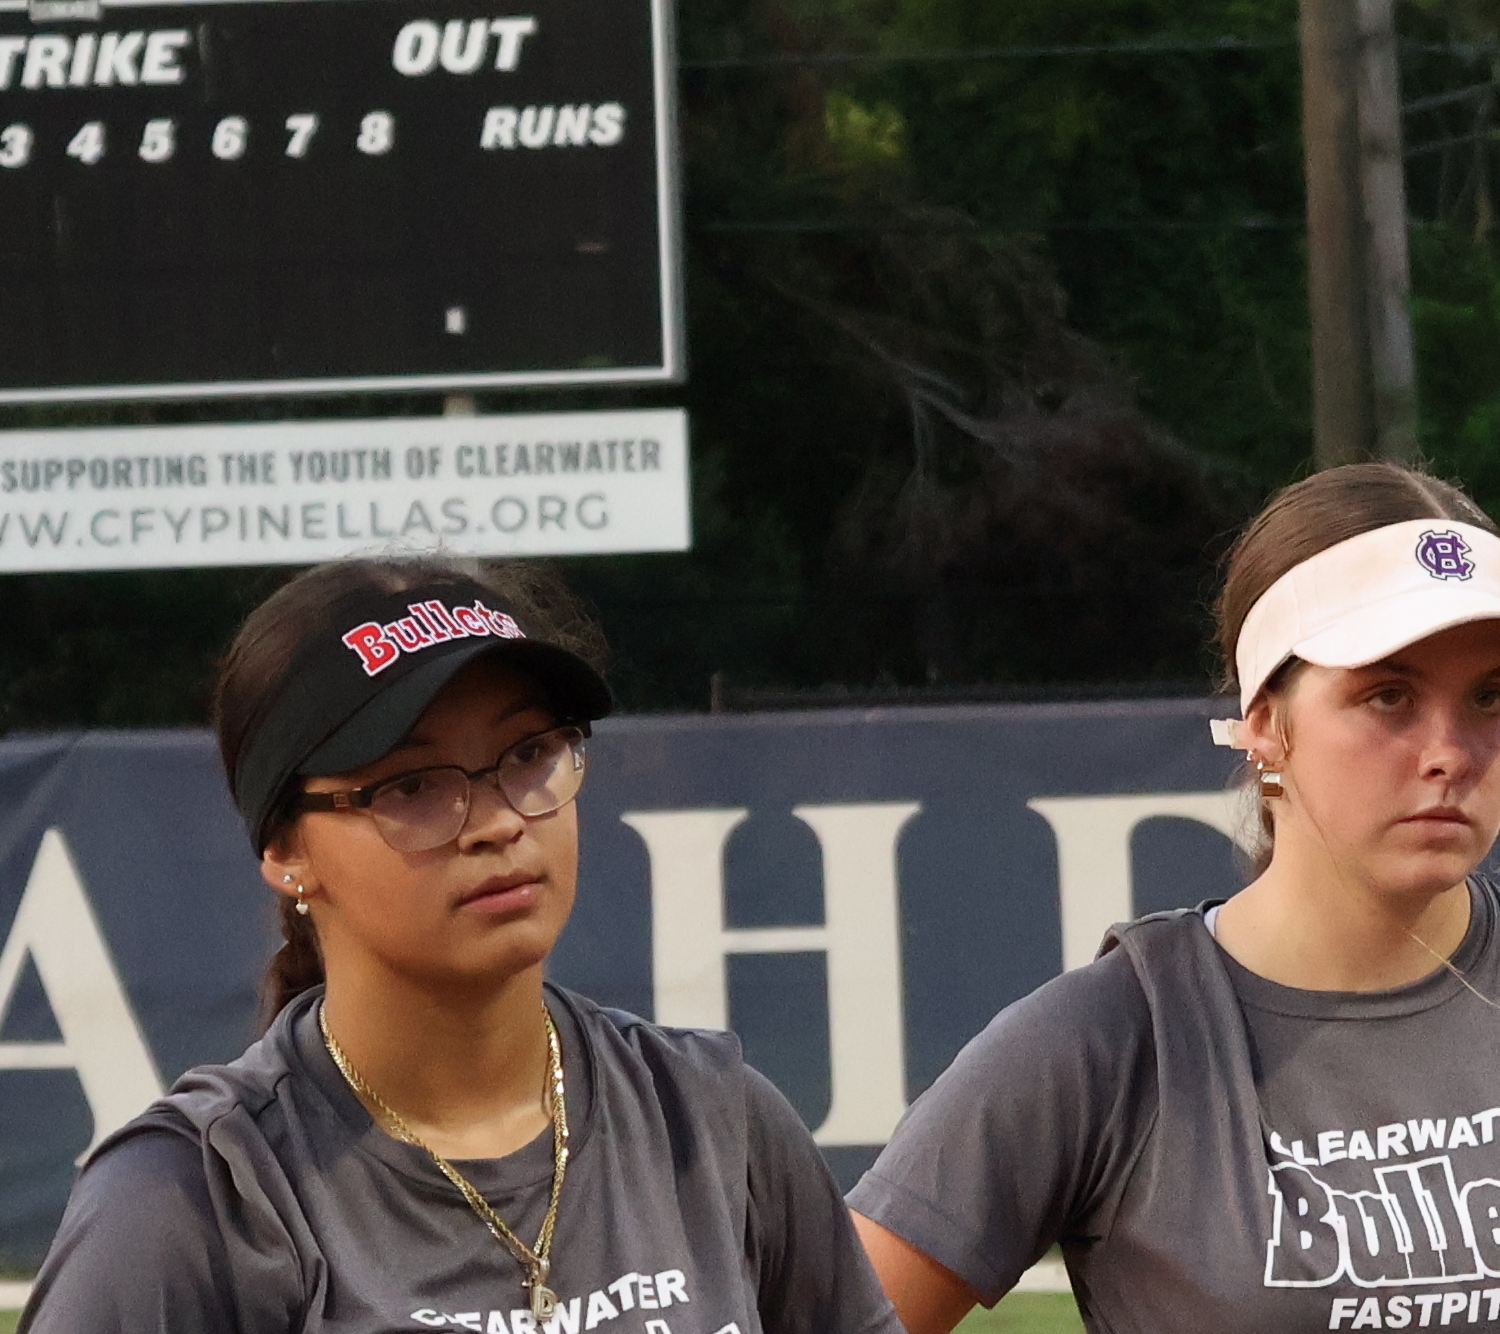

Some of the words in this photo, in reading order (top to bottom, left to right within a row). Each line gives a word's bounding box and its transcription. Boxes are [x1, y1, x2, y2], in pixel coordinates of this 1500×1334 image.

[392, 16, 537, 76] OUT
[66, 120, 105, 165] 4
[138, 119, 175, 162] 5
[211, 116, 248, 159] 6
[284, 114, 319, 157] 7
[356, 111, 394, 154] 8
[480, 103, 624, 150] RUNS
[0, 453, 208, 493] SUPPORTING
[217, 450, 277, 486] THE
[288, 447, 392, 483] YOUTH
[406, 446, 441, 479] OF
[455, 439, 661, 478] CLEARWATER
[342, 600, 527, 677] Bullets
